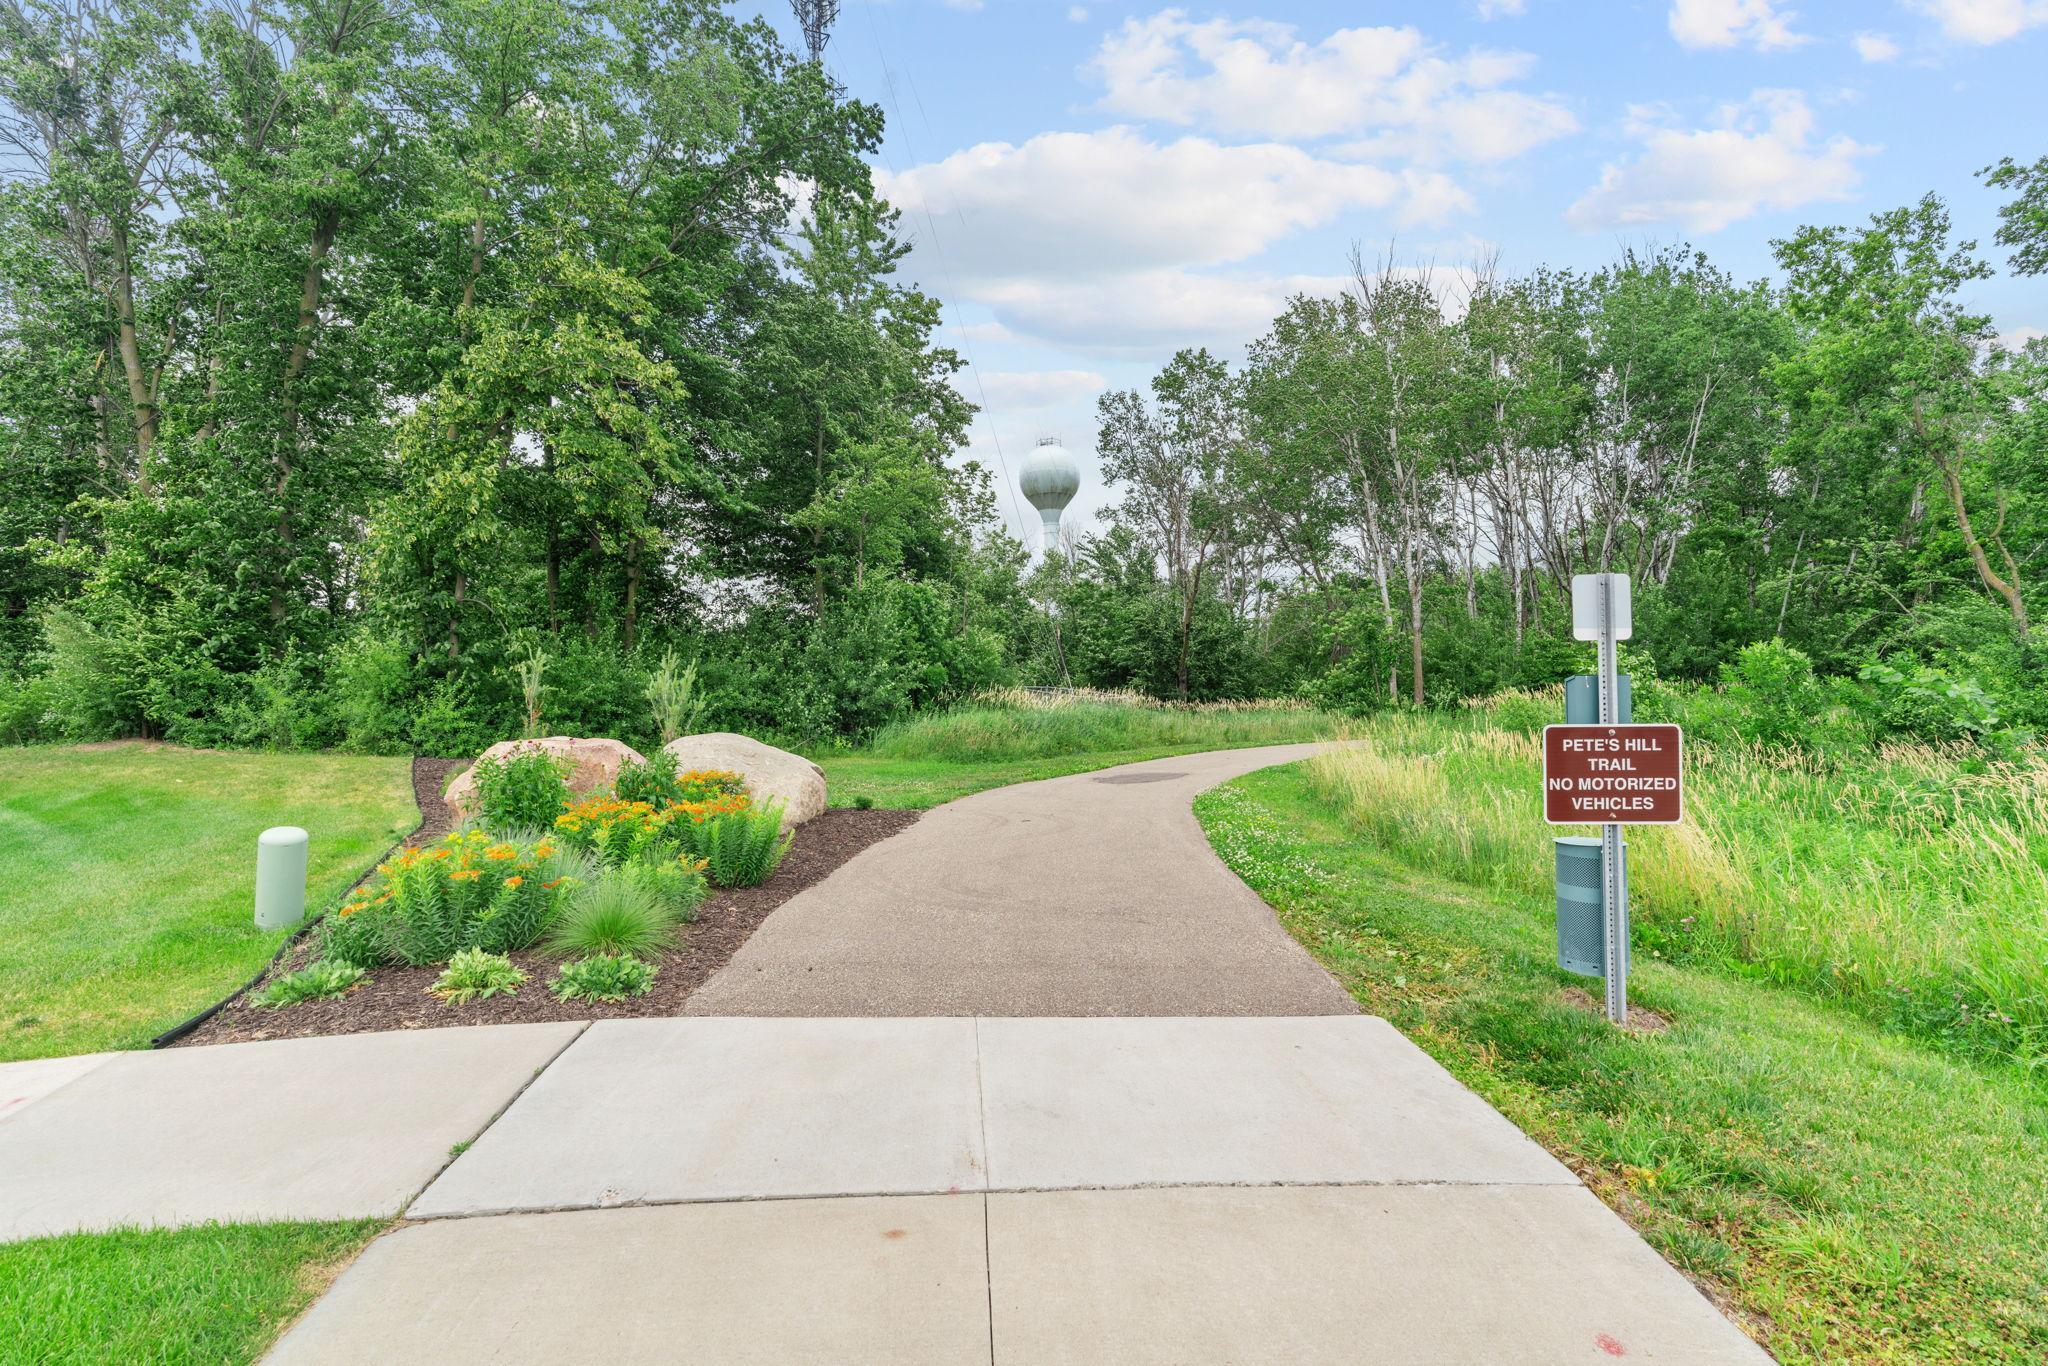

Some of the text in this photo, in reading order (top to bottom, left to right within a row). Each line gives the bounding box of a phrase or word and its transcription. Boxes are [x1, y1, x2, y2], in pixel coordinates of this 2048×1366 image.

[1562, 738, 1662, 751] PETE'S HILL
[1588, 758, 1637, 771] TRAIL
[1549, 777, 1677, 791] NO MOTORIZED
[1571, 797, 1654, 810] VEHICLES
